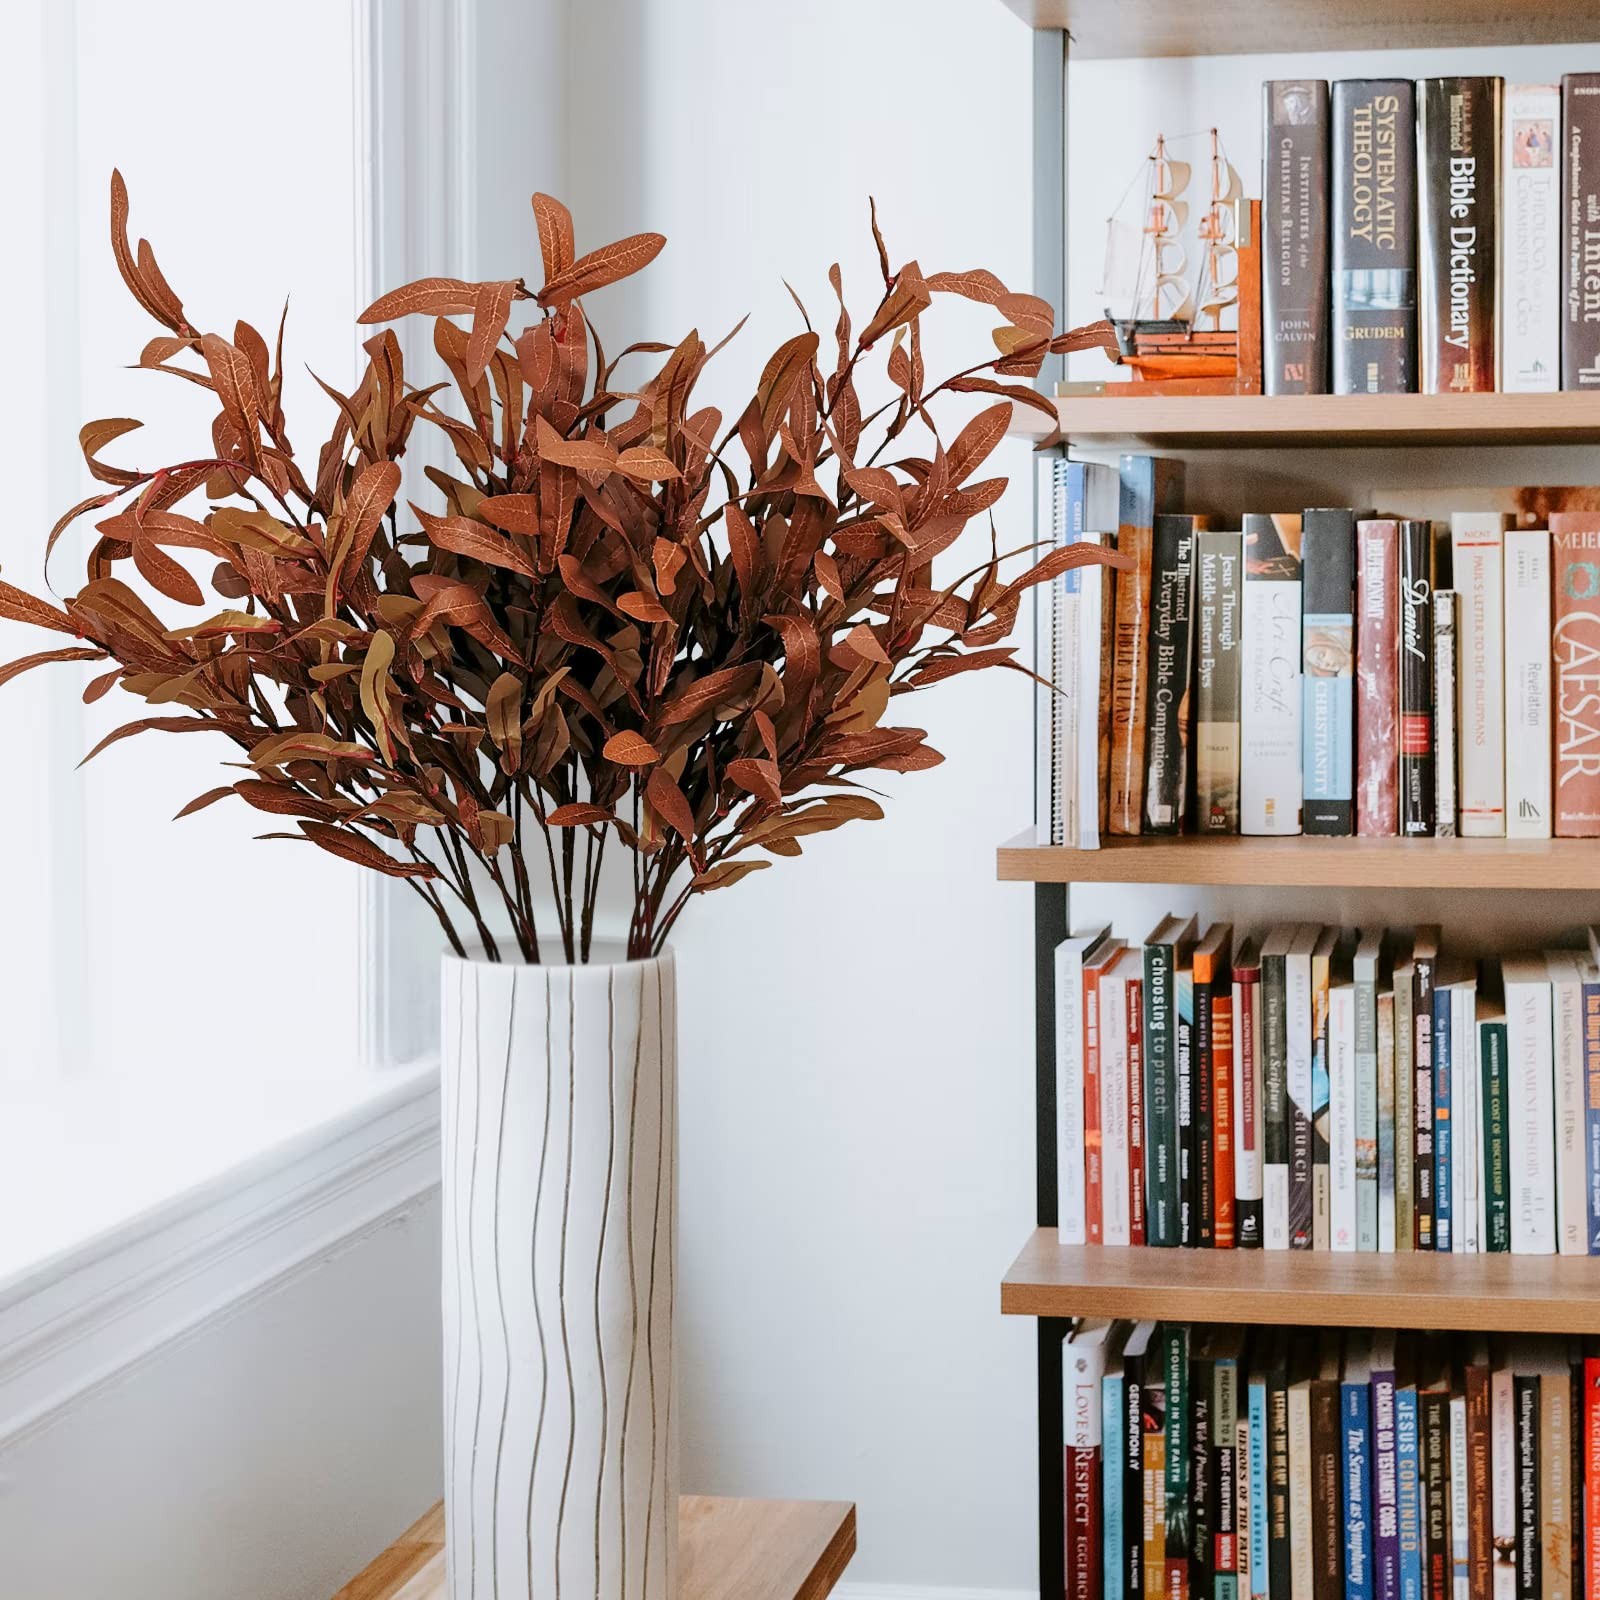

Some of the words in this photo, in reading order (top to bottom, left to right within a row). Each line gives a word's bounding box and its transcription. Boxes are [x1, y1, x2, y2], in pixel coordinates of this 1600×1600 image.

[1450, 94, 1463, 151] Illustrated
[1463, 90, 1472, 154] HOLMAN
[1572, 126, 1581, 134] A
[1281, 138, 1293, 214] CHRISTIAN
[1350, 103, 1374, 244] THEOLOGY
[1374, 95, 1401, 250] SYSTEMATIC
[1449, 157, 1476, 218] Bible
[1571, 199, 1581, 225] Guide
[1587, 195, 1598, 223] with
[1572, 226, 1580, 235] to
[1572, 236, 1581, 251] the
[1281, 220, 1293, 287] RELIGION
[1445, 226, 1476, 349] Dictionary
[1569, 289, 1581, 299] of
[1584, 230, 1600, 322] Intent
[1275, 332, 1315, 342] CALVIN
[1280, 320, 1310, 329] JOHN
[1343, 327, 1404, 340] GRUDEM
[1178, 538, 1192, 560] The
[1553, 531, 1600, 549] MEIE
[1202, 553, 1216, 601] Middle
[1220, 553, 1236, 588] Jesus
[1367, 539, 1385, 620] DEUTERONOMY
[1155, 570, 1178, 640] Everyday
[1176, 563, 1191, 621] Illustrated
[1202, 606, 1216, 653] Eastern
[1219, 591, 1236, 651] Through
[1402, 577, 1430, 662] Daniel
[1117, 623, 1142, 667] BIBLE
[1157, 645, 1176, 685] Bible
[1200, 658, 1216, 688] Eyes
[1116, 677, 1140, 724] ATLAS
[1527, 662, 1542, 726] Revelation
[1552, 611, 1600, 787] CAESAR
[1151, 688, 1172, 779] Companion
[1314, 681, 1327, 795] CHRISTIANITY
[1150, 957, 1167, 1030] choosing
[1268, 998, 1279, 1013] The
[1179, 1025, 1190, 1045] OUT
[1198, 992, 1208, 1048] reviewing
[1243, 1013, 1252, 1056] GROWING
[1268, 1016, 1279, 1045] Drama
[1357, 984, 1375, 1050] Preaching
[1154, 1036, 1167, 1053] to
[1179, 1046, 1190, 1073] FROM
[1268, 1047, 1279, 1058] of
[1151, 1059, 1168, 1115] preach
[1199, 1053, 1210, 1113] leadership
[1216, 1065, 1228, 1080] THE
[1243, 1059, 1252, 1079] TRUE
[1266, 1059, 1282, 1113] Scripture
[1490, 1078, 1500, 1095] THE
[1131, 1105, 1141, 1116] OF
[1179, 1075, 1191, 1127] DARKNESS
[1217, 1087, 1229, 1128] MASTER'S
[1244, 1082, 1253, 1124] DISCIPLES
[1491, 1098, 1501, 1120] COST
[1132, 1117, 1141, 1148] CHRIST
[1294, 1109, 1307, 1183] CHURCH
[1492, 1123, 1501, 1135] OF
[1157, 1144, 1168, 1182] anderson
[1492, 1138, 1503, 1195] DISCIPLESHIP
[1171, 1339, 1181, 1402] GROUNDED
[1075, 1383, 1094, 1429] LOVE
[1171, 1406, 1181, 1419] IN
[1196, 1400, 1208, 1418] The
[1221, 1369, 1231, 1421] PREACHING
[1376, 1382, 1394, 1430] CRACKING
[1429, 1403, 1440, 1425] THE
[1129, 1384, 1140, 1457] GENERATION
[1171, 1423, 1181, 1445] THE
[1221, 1424, 1231, 1435] TO
[1252, 1407, 1261, 1429] THE
[1398, 1401, 1415, 1453] JESUS
[1519, 1389, 1534, 1466] Anthropological
[1076, 1433, 1090, 1445] &
[1194, 1443, 1208, 1455] of
[1238, 1429, 1248, 1481] HEROES
[1252, 1437, 1262, 1477] JESUS
[1348, 1429, 1364, 1453] The
[1377, 1431, 1394, 1450] OLD
[1430, 1428, 1441, 1459] POOR
[1454, 1410, 1465, 1478] CHRISTIAN
[1171, 1448, 1181, 1483] FAITH
[1194, 1456, 1208, 1502] Preaching
[1326, 1454, 1336, 1513] CELEBRATION
[1348, 1454, 1365, 1502] Sermon
[1378, 1451, 1396, 1505] TESTAMENT
[1430, 1462, 1442, 1487] WILL
[1074, 1447, 1095, 1526] RESPECT
[1220, 1448, 1232, 1532] POST-EVERYTHING
[1239, 1485, 1248, 1498] OF
[1253, 1483, 1262, 1497] OF
[1431, 1490, 1442, 1506] BE
[1455, 1480, 1466, 1528] BELIEFS
[1520, 1468, 1535, 1508] Insights
[1239, 1506, 1248, 1529] THE
[1328, 1515, 1336, 1526] OF
[1350, 1504, 1362, 1518] as
[1379, 1506, 1396, 1537] CODES
[1431, 1509, 1443, 1539] GLAD
[1522, 1509, 1534, 1524] for
[1131, 1546, 1139, 1558] TIM
[1220, 1535, 1232, 1569] WORLD
[1240, 1536, 1249, 1575] FAITH
[1253, 1504, 1263, 1568] SUBURBIA
[1327, 1528, 1337, 1576] DISCIPLINE
[1347, 1520, 1367, 1585] Symphony
[1131, 1560, 1139, 1590] ELMORE
[1521, 1525, 1536, 1588] Missionaries
